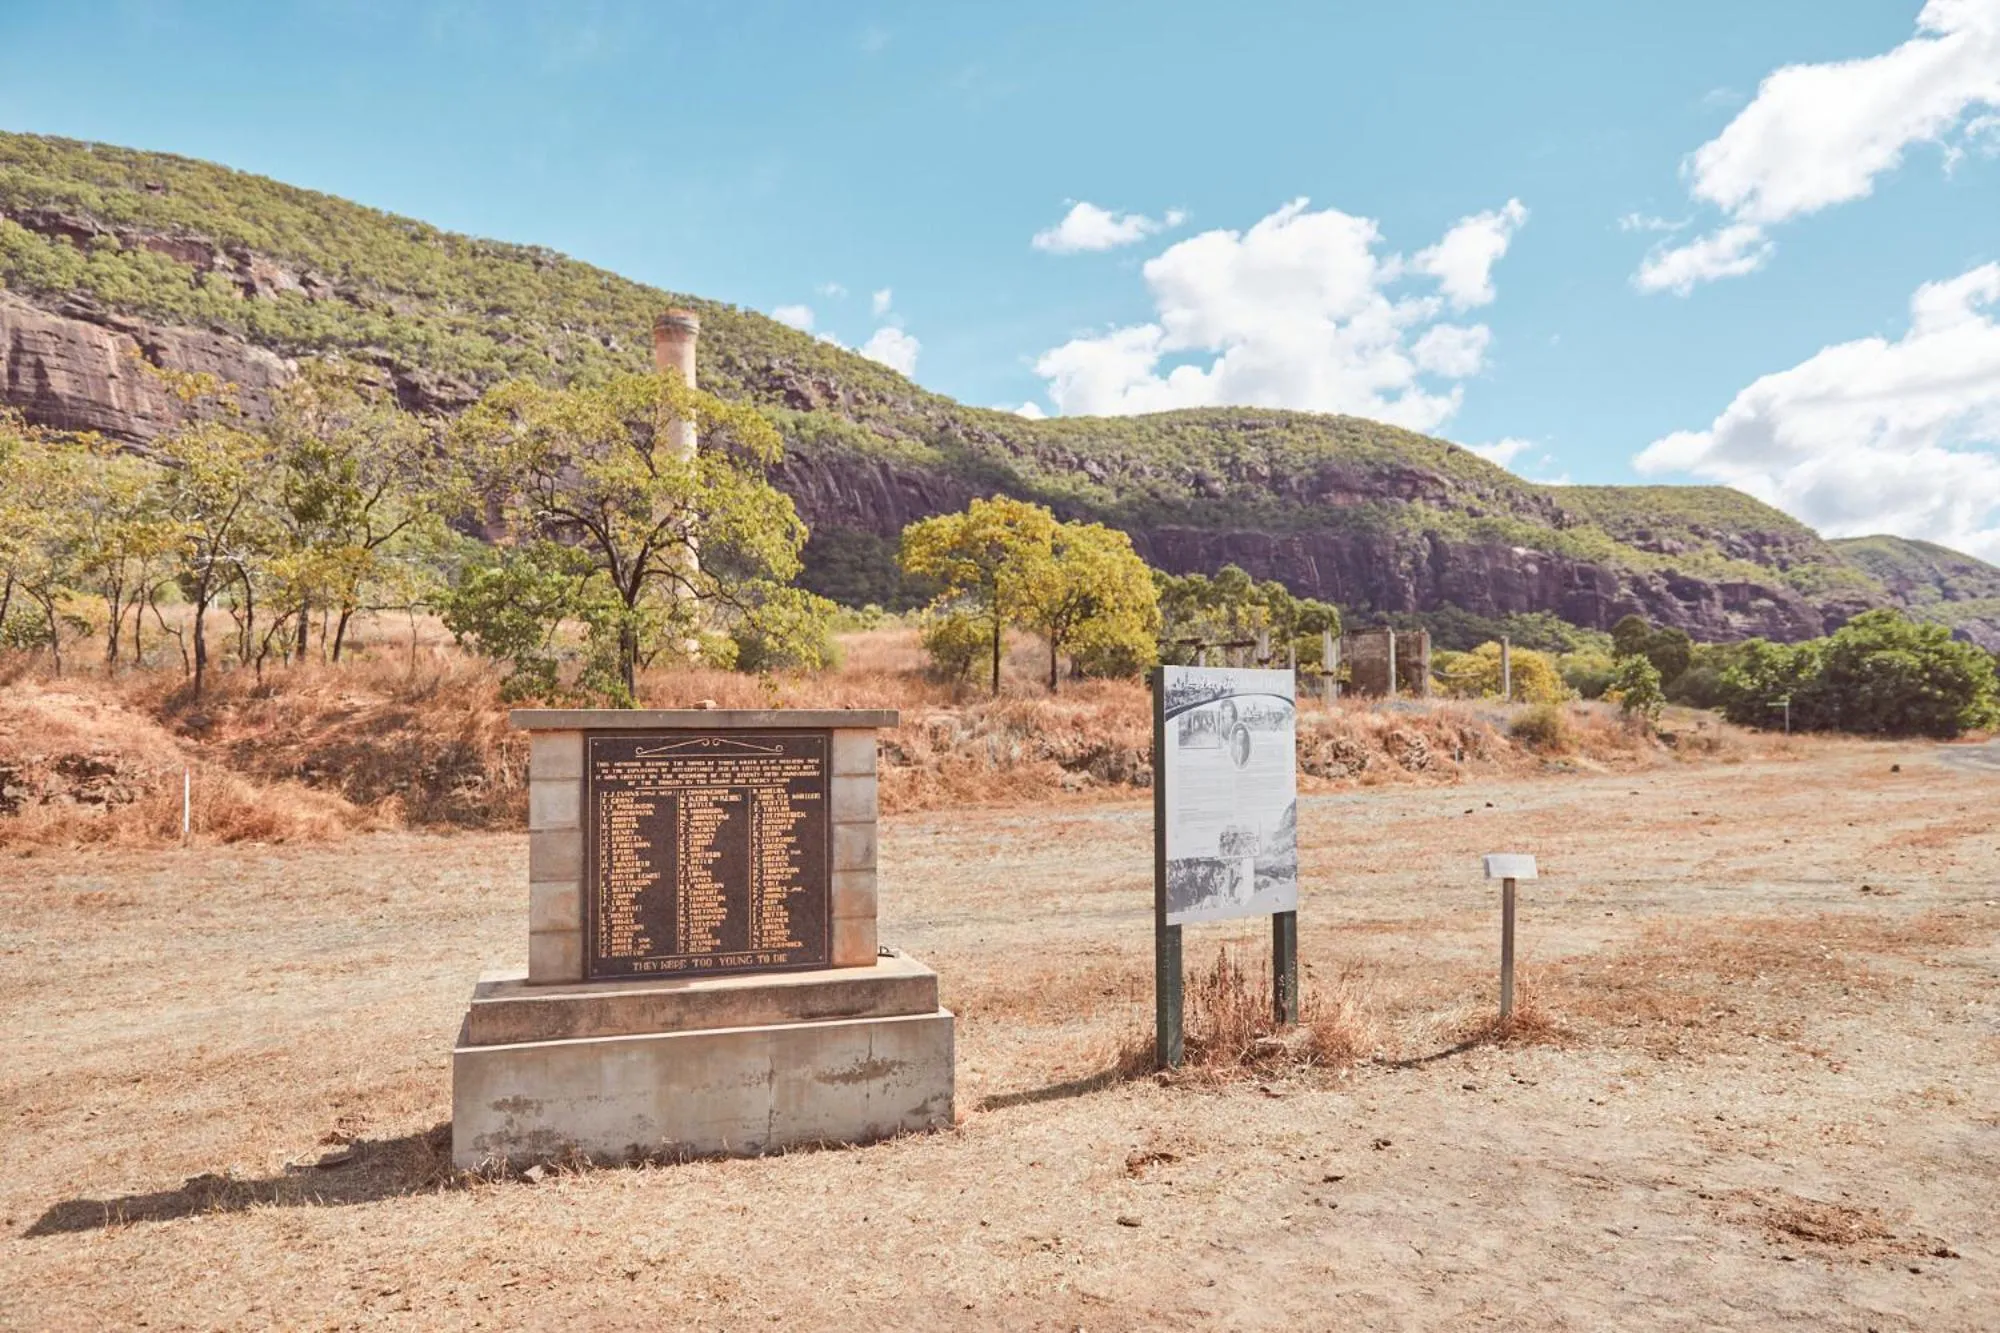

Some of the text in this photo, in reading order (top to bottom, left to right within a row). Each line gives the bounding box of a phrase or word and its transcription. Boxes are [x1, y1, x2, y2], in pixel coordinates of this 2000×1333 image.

[632, 961, 657, 971] THEY
[692, 957, 713, 968] TOO
[719, 956, 753, 967] YOUNG
[758, 954, 769, 964] TO
[772, 953, 788, 963] DIE
